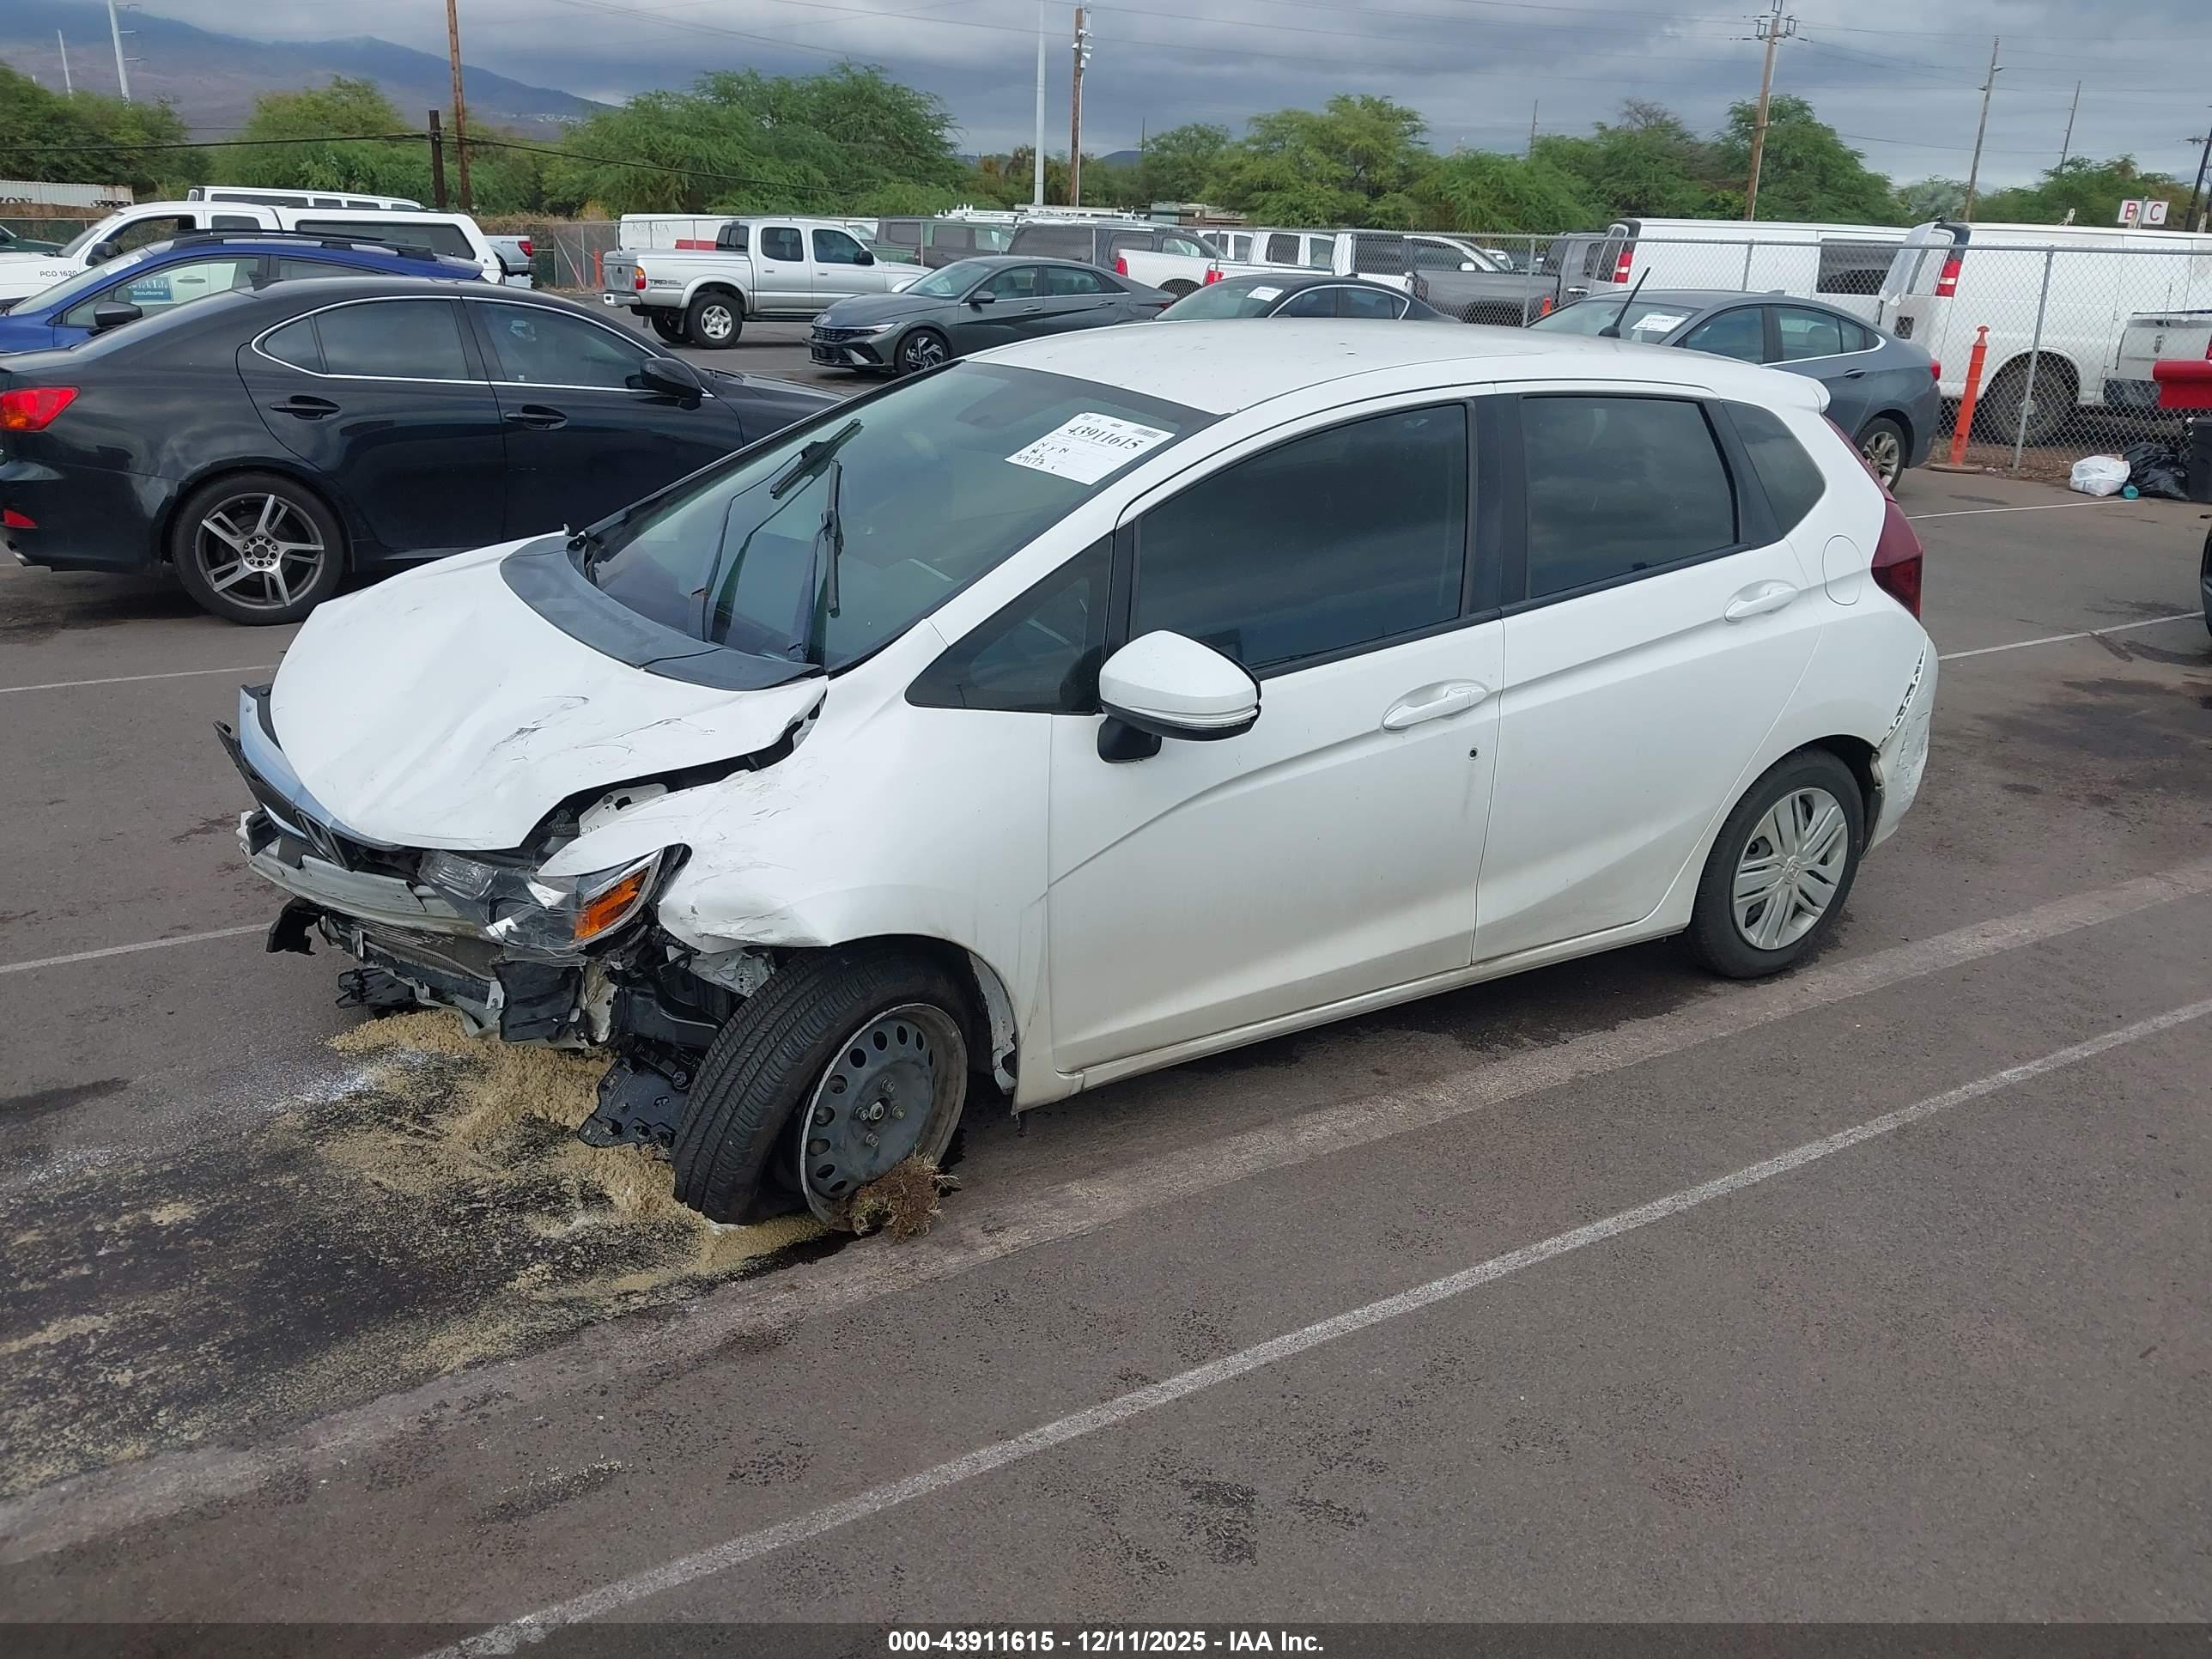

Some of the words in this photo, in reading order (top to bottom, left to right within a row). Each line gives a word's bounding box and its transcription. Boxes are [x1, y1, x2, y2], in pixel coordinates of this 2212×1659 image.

[2124, 203, 2138, 220] B
[2150, 204, 2163, 222] C
[1068, 426, 1145, 449] 43911615
